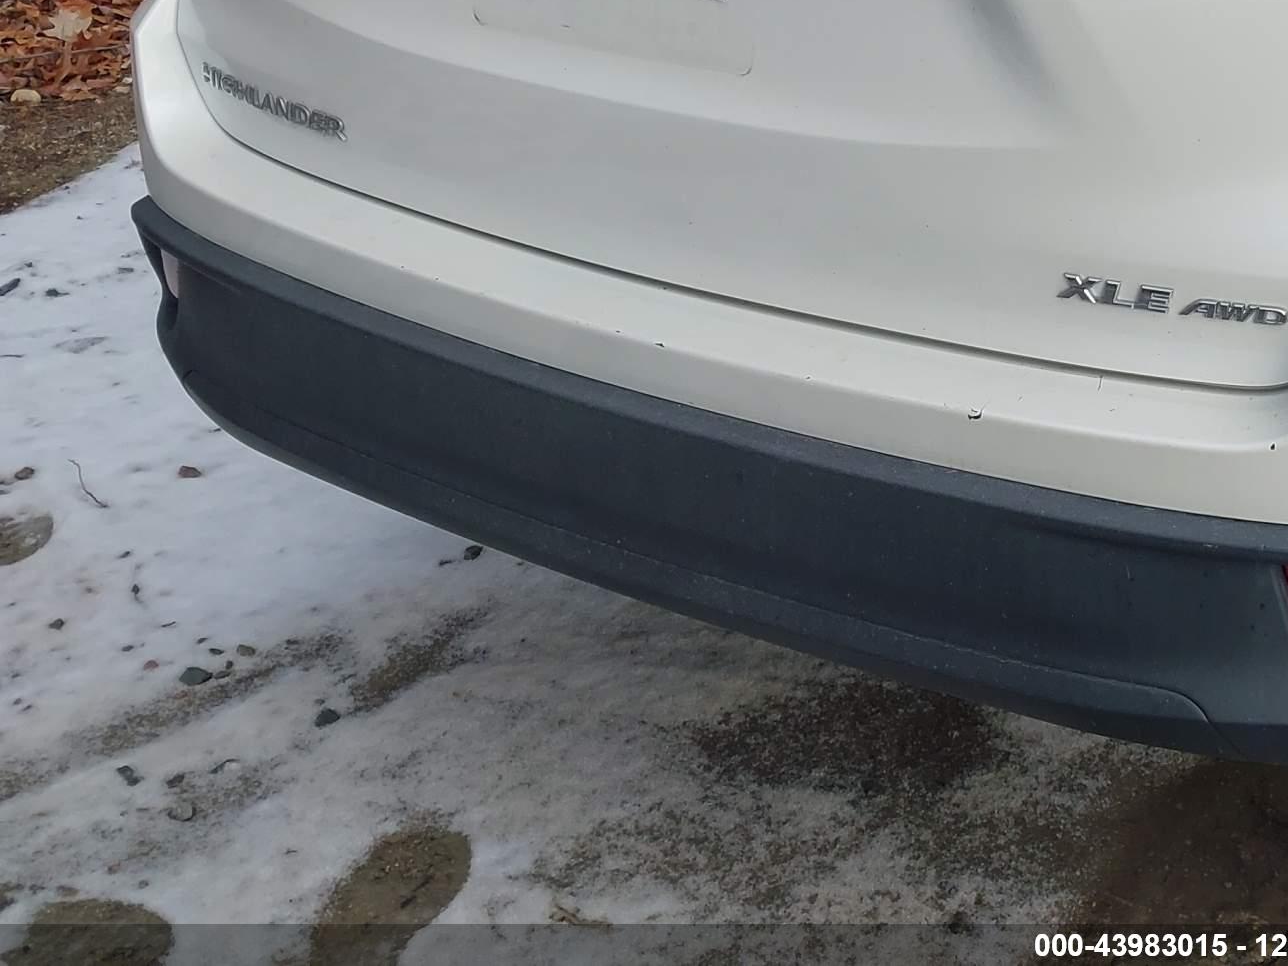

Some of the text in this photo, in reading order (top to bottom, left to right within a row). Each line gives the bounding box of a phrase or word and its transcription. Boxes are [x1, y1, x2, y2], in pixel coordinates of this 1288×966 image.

[202, 61, 348, 141] HIGHLANDER
[1056, 272, 1288, 326] XLE AWD
